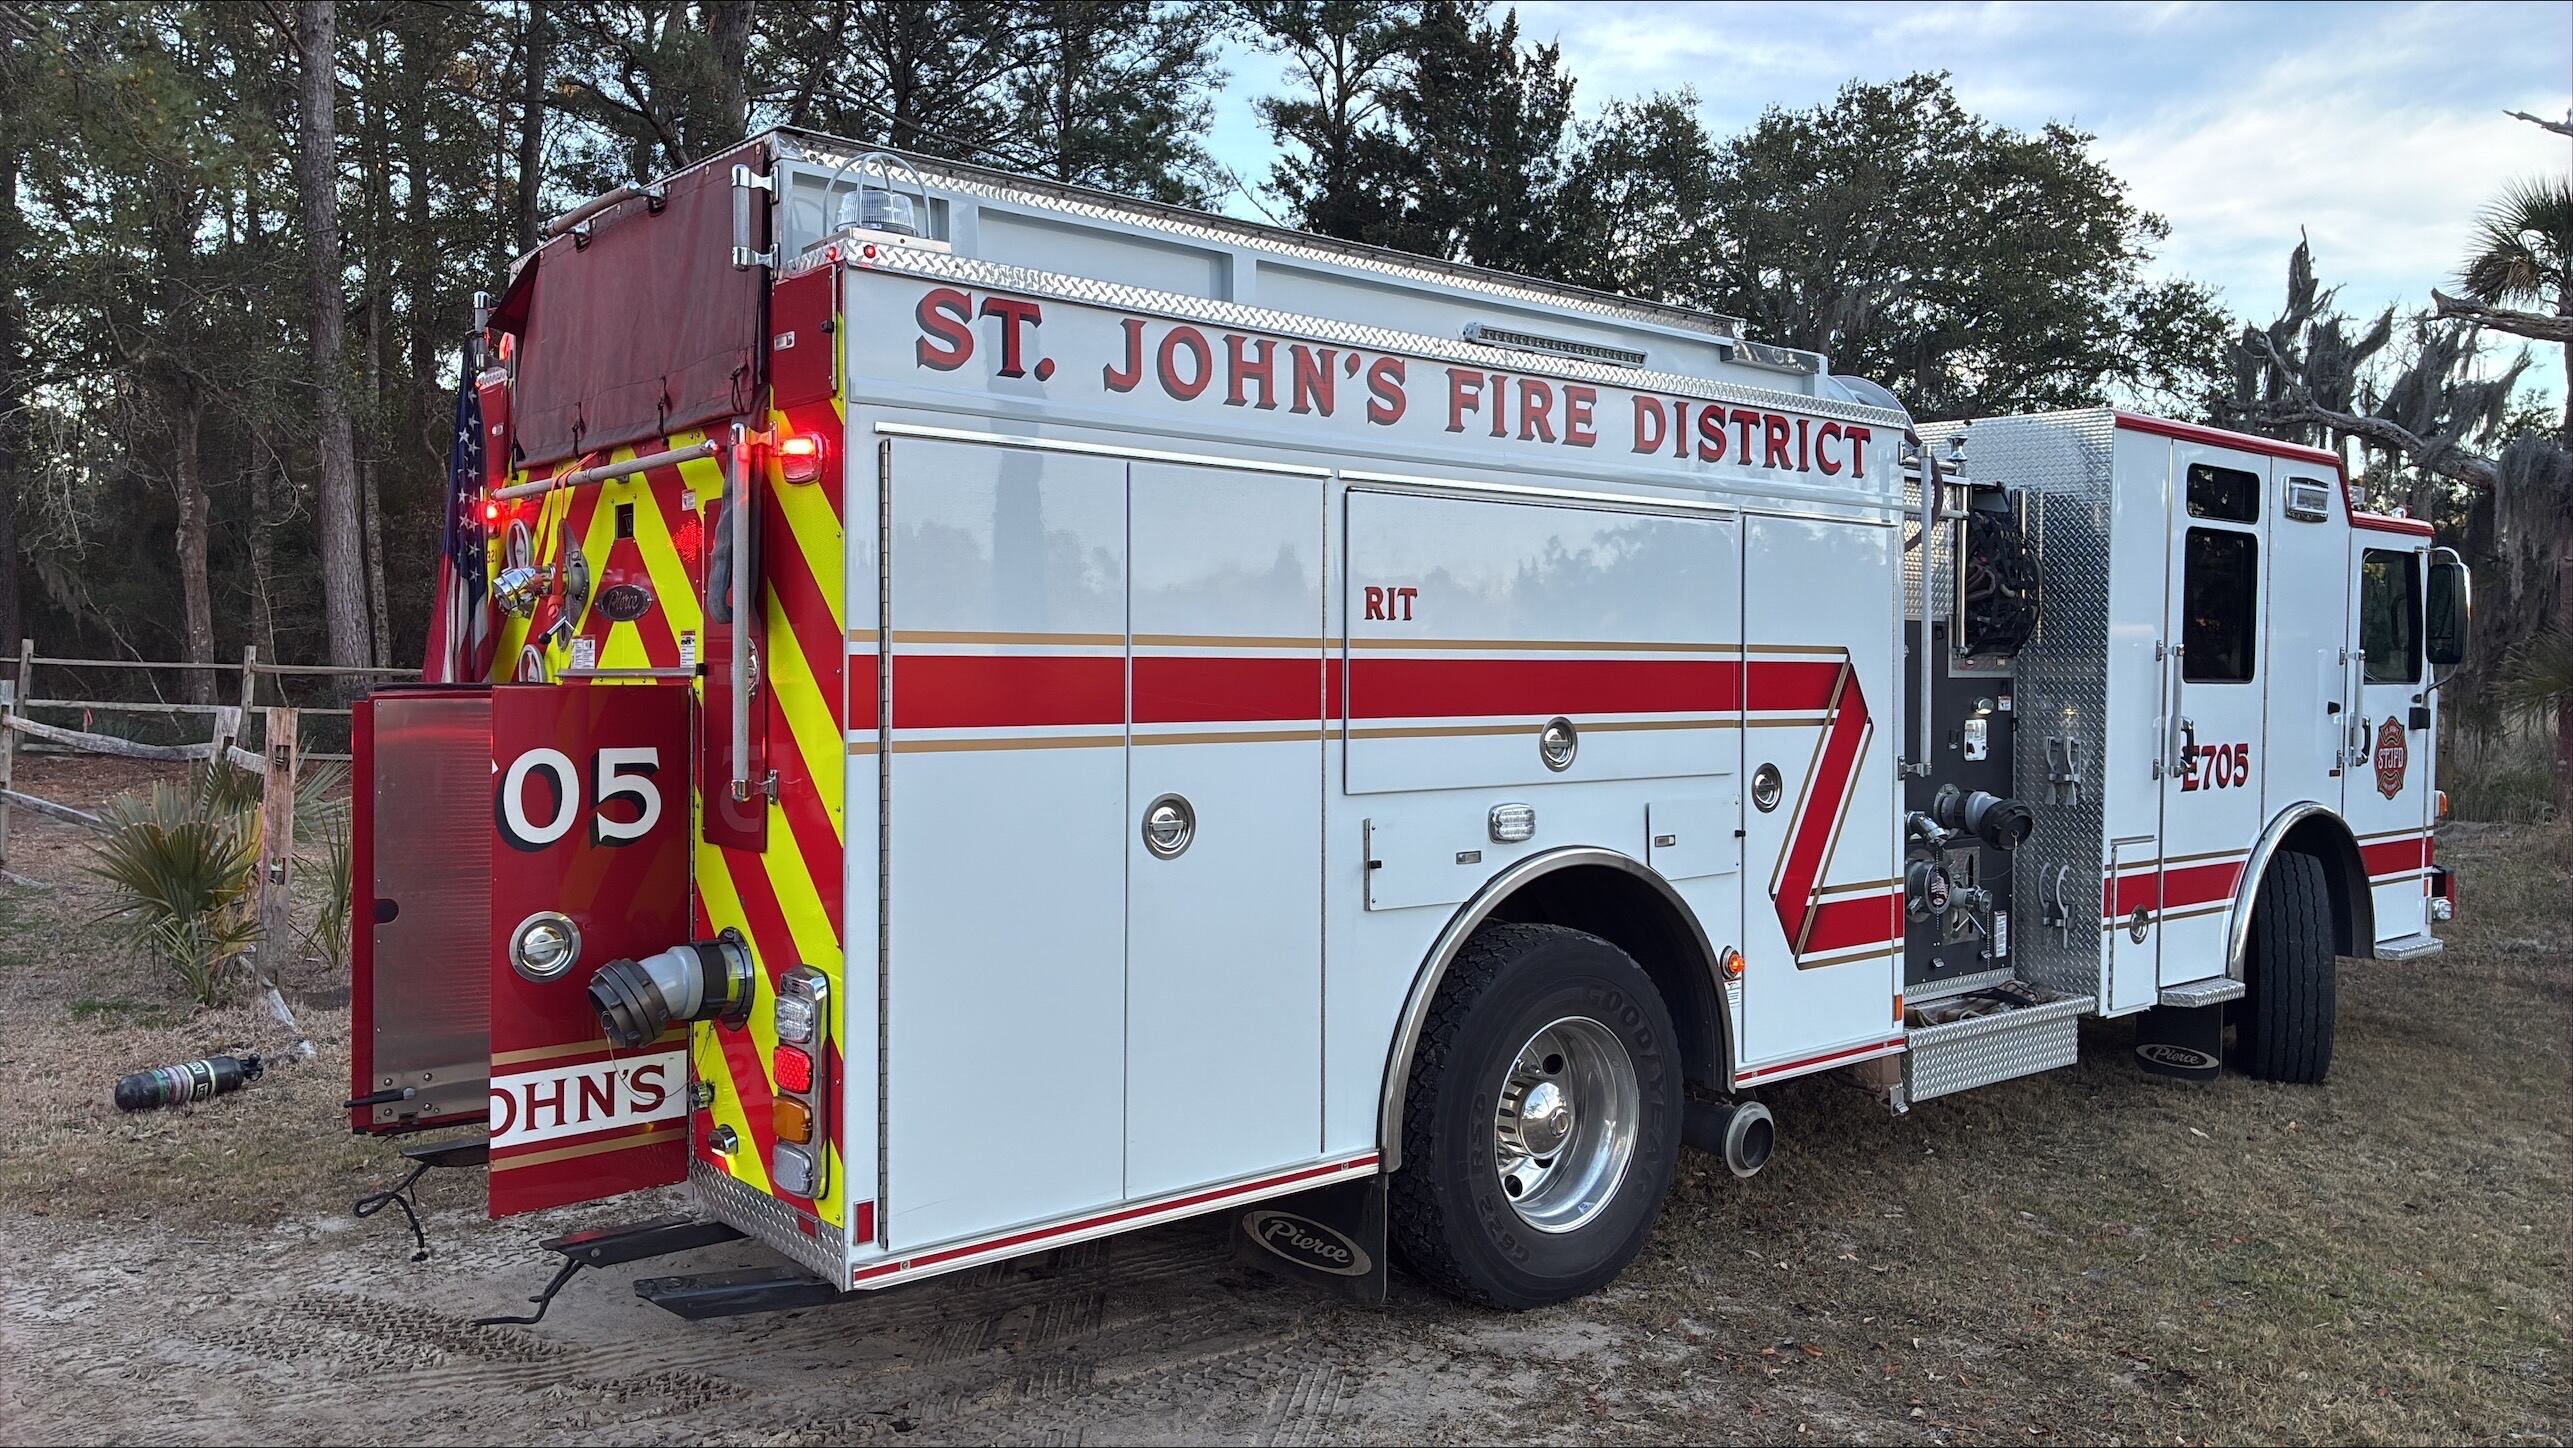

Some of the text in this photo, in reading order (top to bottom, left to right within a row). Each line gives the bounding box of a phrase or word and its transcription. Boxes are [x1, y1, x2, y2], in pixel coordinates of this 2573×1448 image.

[915, 287, 1872, 479] ST. JOHN'S FIRE DISTRICT
[1364, 586, 1418, 621] RIT
[2181, 742, 2250, 792] E705
[2377, 746, 2404, 770] STJFD
[492, 747, 662, 852] 05
[2153, 1047, 2200, 1065] Pierce
[1264, 1219, 1350, 1263] Pierce
